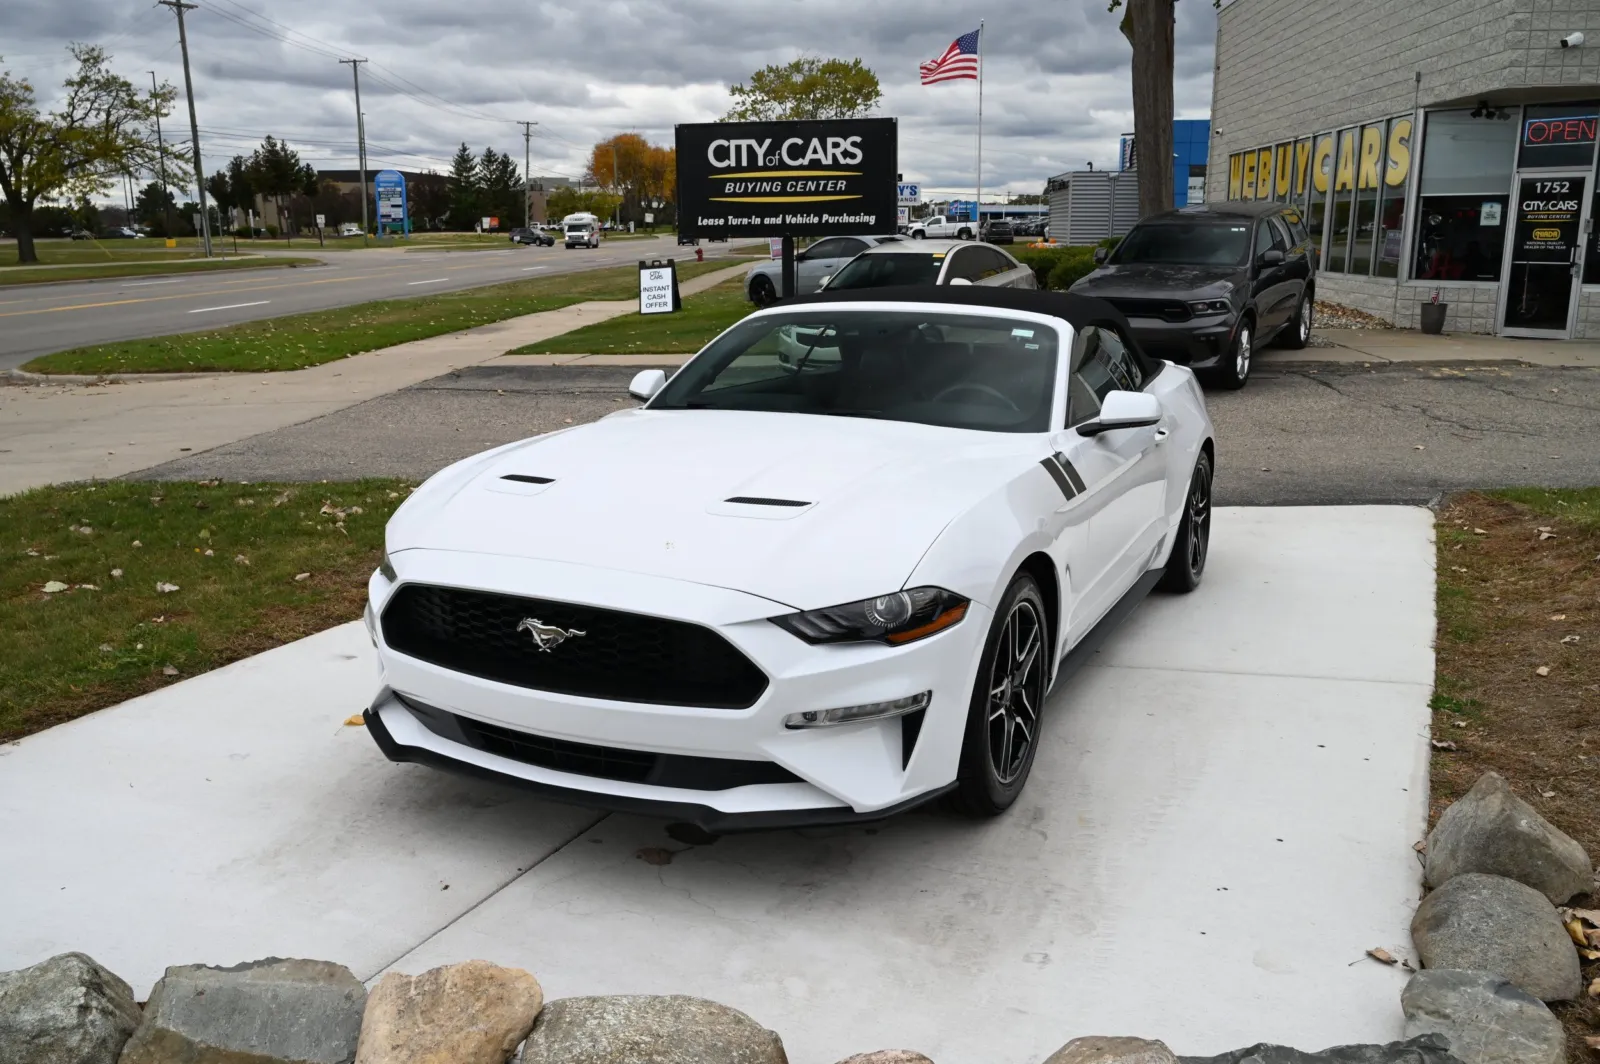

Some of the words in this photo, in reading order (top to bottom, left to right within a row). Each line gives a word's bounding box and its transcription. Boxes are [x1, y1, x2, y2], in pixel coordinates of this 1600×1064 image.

[1528, 120, 1596, 141] OPEN
[707, 139, 772, 168] CITY
[766, 150, 780, 166] of
[781, 136, 863, 166] CARS
[1313, 120, 1412, 194] CARS
[724, 181, 782, 194] BUYING
[786, 180, 847, 192] CENTER
[1535, 181, 1570, 194] 1752
[1523, 200, 1547, 211] CITY
[1548, 200, 1579, 211] CARS
[697, 216, 725, 226] Lease
[727, 215, 761, 225] Turn-In
[763, 214, 783, 225] and
[785, 213, 819, 224] Vehicle
[821, 212, 876, 225] Purchasing
